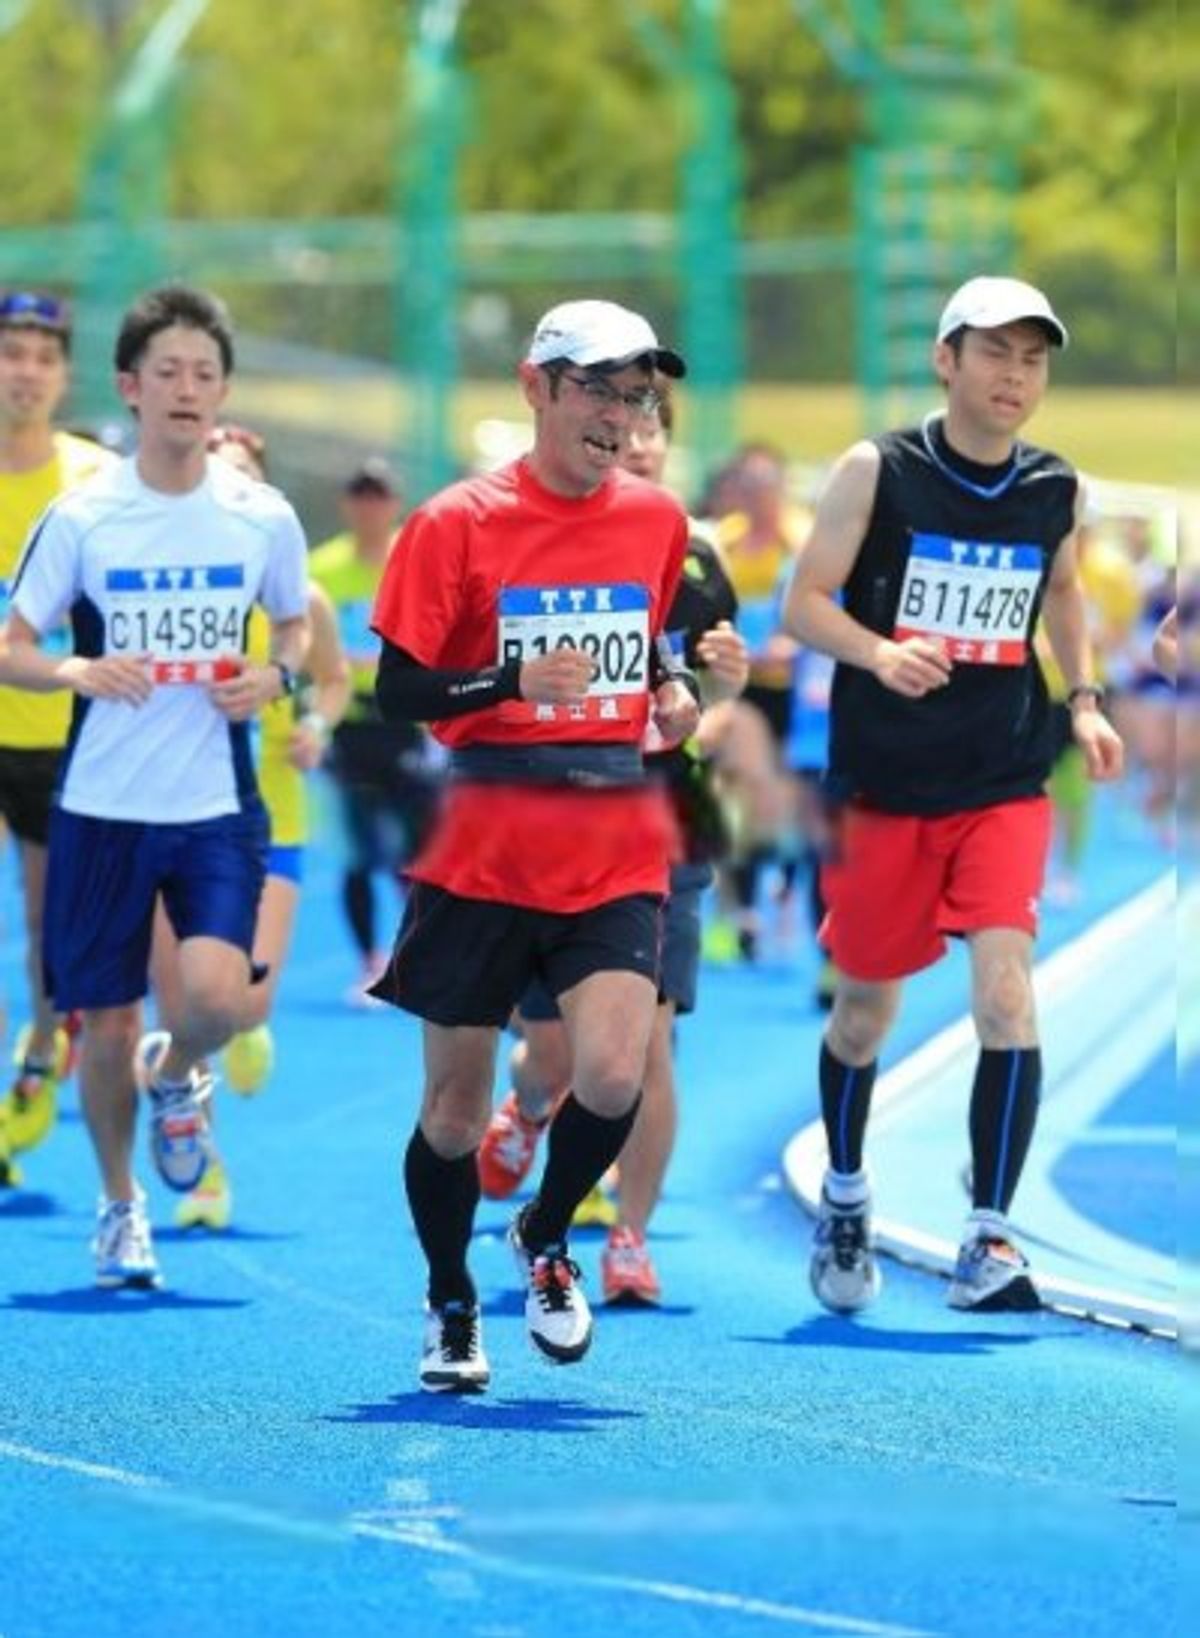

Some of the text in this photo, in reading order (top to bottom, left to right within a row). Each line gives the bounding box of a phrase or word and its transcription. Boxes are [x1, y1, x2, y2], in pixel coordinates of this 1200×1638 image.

[951, 540, 1013, 569] TTK
[142, 568, 210, 590] TTK
[539, 587, 613, 613] TTK
[903, 578, 1030, 630] B11478
[110, 605, 238, 651] C14584
